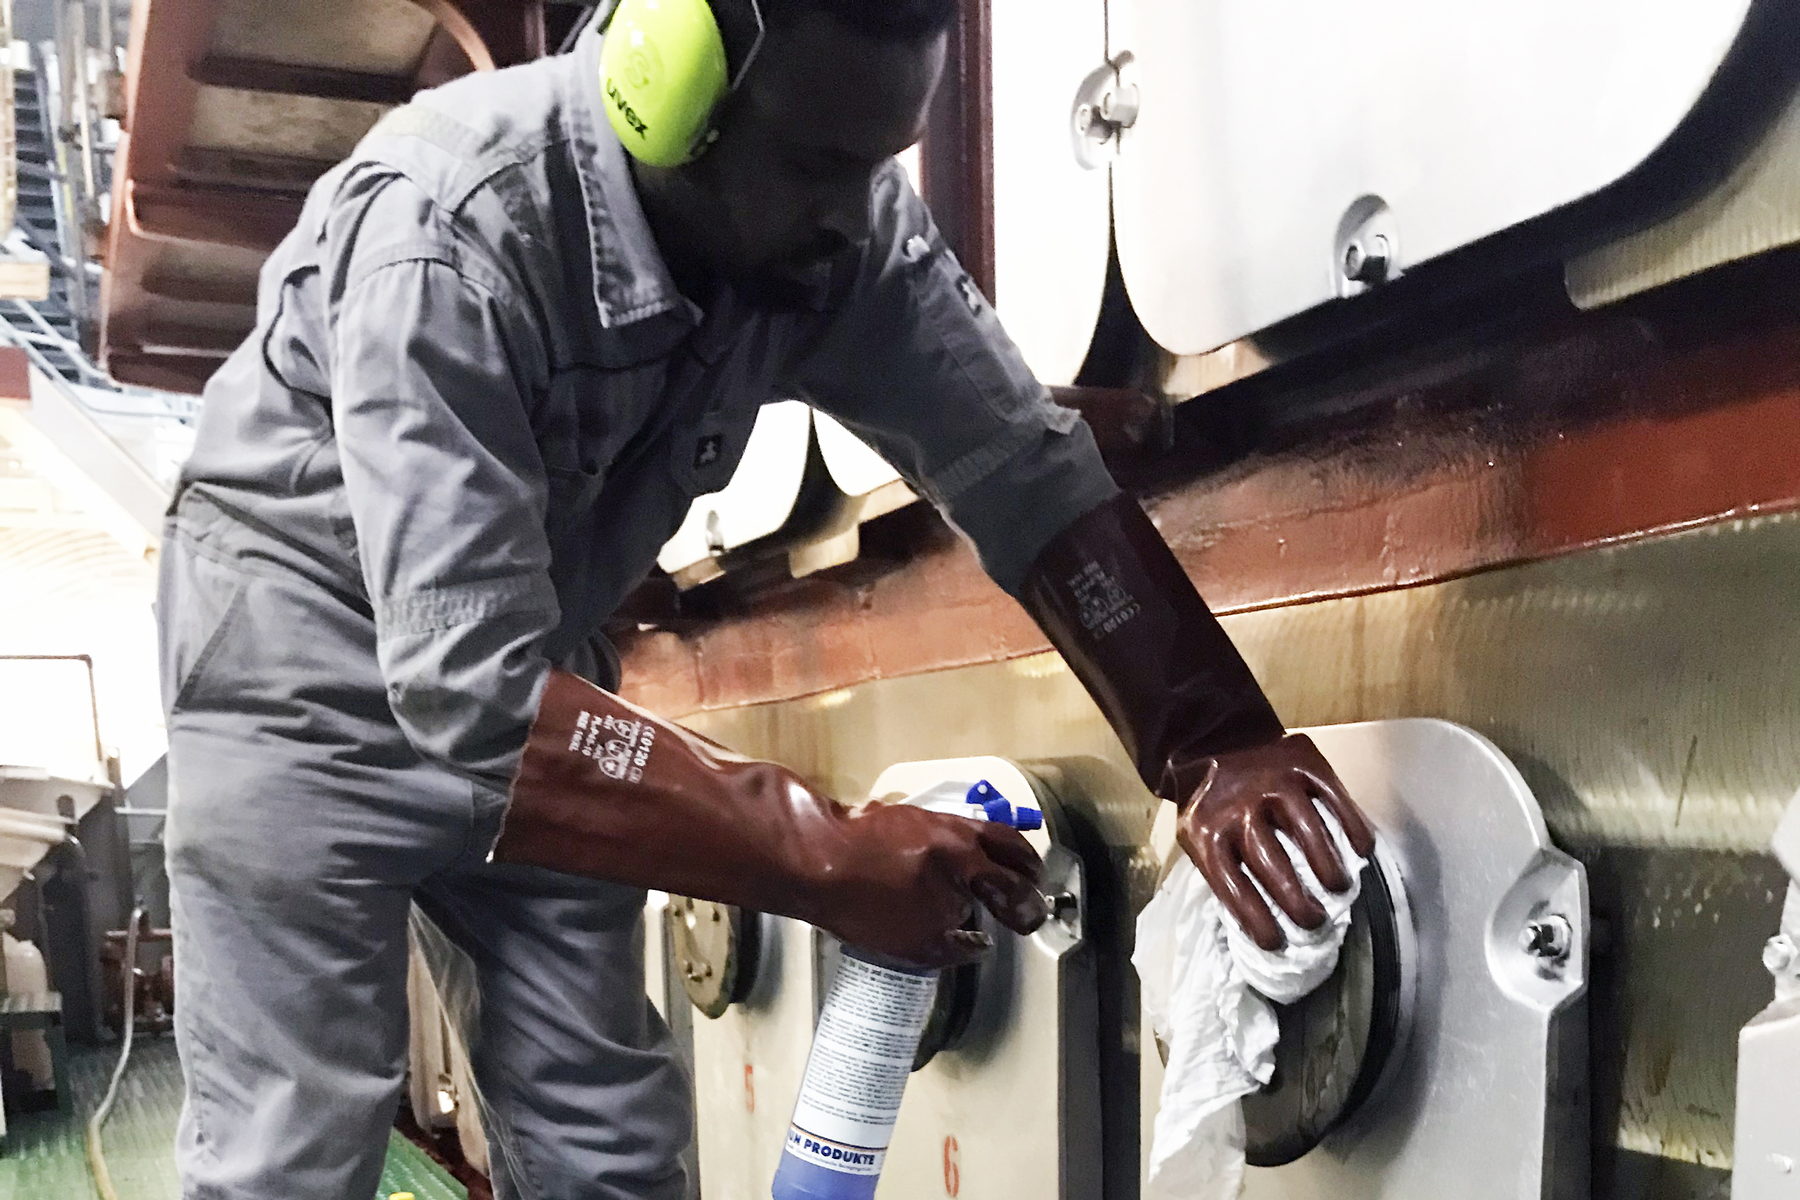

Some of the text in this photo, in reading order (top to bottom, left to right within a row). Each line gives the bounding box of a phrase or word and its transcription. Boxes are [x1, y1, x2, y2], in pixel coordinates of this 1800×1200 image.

[606, 78, 648, 140] uvex
[804, 1139, 875, 1165] PRODUKTE
[944, 1134, 960, 1198] 6
